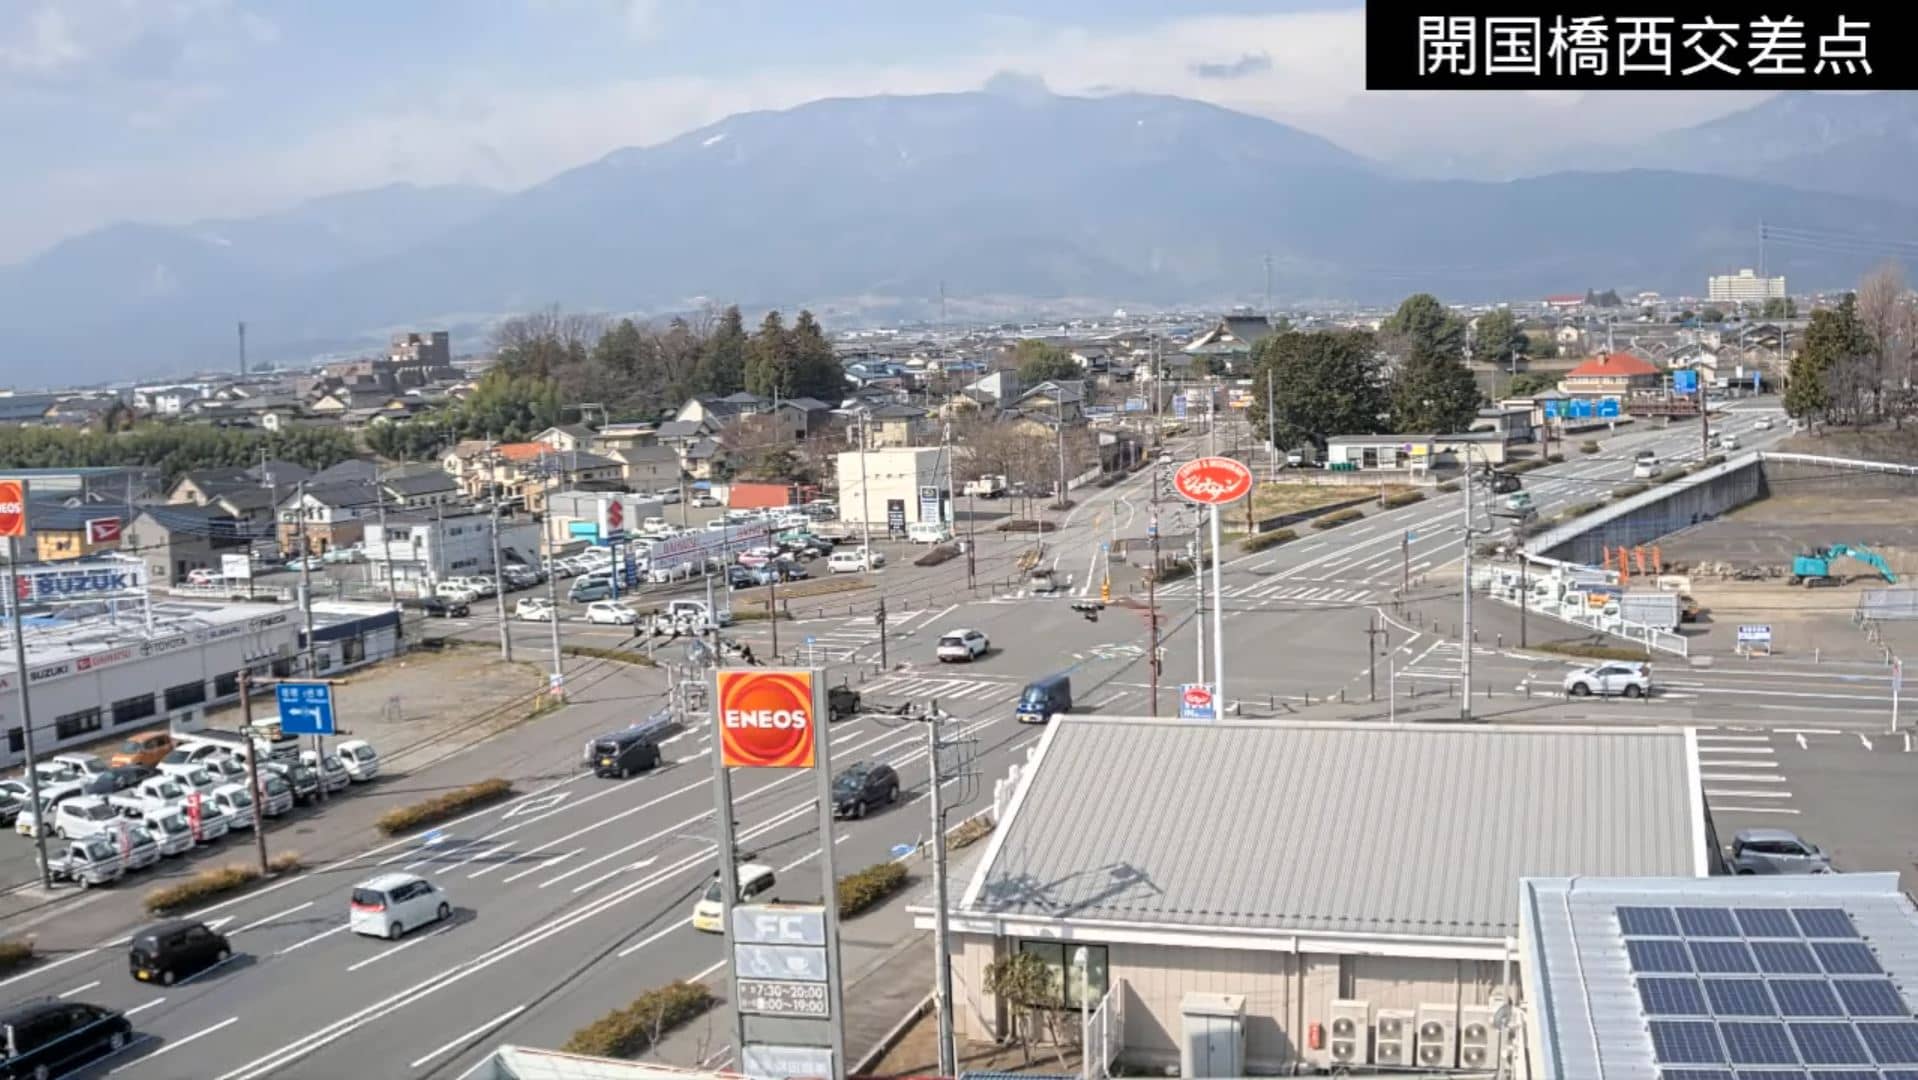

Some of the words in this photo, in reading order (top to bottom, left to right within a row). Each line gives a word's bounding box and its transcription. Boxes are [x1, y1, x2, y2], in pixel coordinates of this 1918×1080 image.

[0, 501, 21, 514] EOS
[37, 573, 138, 594] SUZUKI
[153, 637, 188, 652] TOYOTA
[30, 665, 69, 681] SUZUKI
[725, 709, 807, 729] ENEOS
